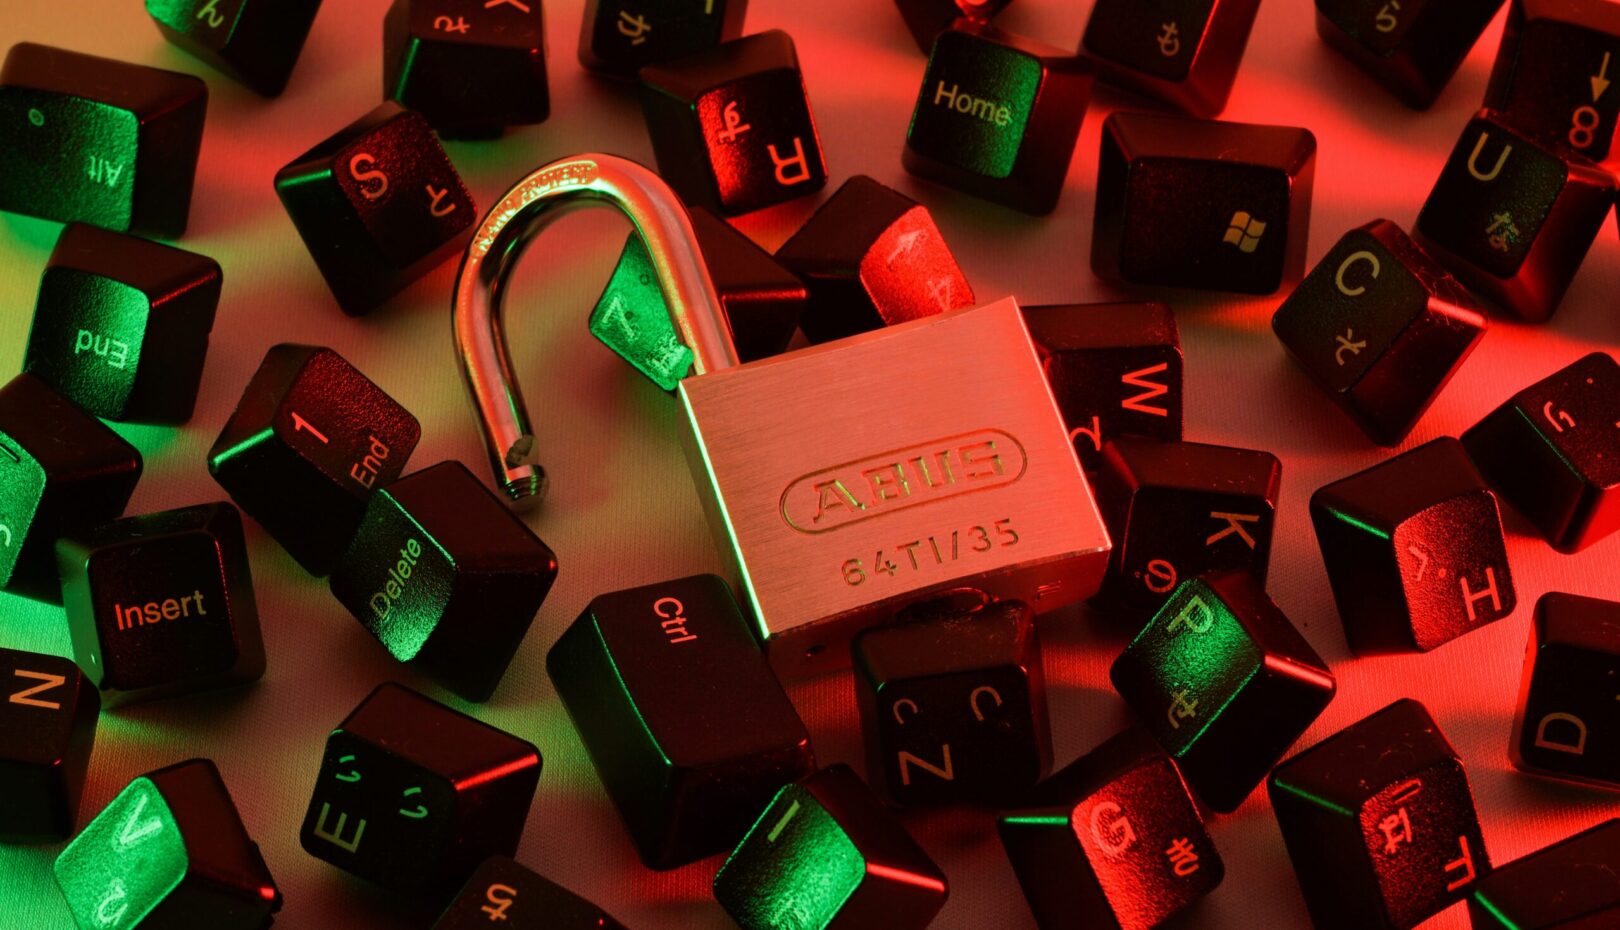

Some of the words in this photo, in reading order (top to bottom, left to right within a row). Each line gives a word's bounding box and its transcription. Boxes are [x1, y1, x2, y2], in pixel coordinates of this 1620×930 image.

[618, 10, 651, 46] か
[718, 100, 751, 142] す
[933, 79, 1013, 128] Home
[1568, 105, 1600, 149] 8
[87, 156, 124, 188] Alt
[350, 153, 388, 199] S
[766, 137, 811, 186] R
[1467, 131, 1513, 182] U
[425, 184, 457, 218] と
[1335, 250, 1381, 297] C
[74, 329, 129, 369] End
[1335, 328, 1367, 367] そ
[1121, 362, 1169, 418] W
[291, 411, 329, 445] 1
[350, 434, 390, 490] End
[812, 440, 1004, 524] ABUS
[1206, 510, 1261, 551] K
[369, 538, 422, 621] Delete
[1144, 559, 1177, 593] の
[1460, 567, 1502, 622] H
[114, 589, 207, 631] Insert
[653, 597, 698, 644] Ctrl
[1167, 595, 1214, 634] P
[1534, 711, 1588, 755] D
[119, 793, 163, 845] V
[313, 801, 367, 854] E
[1090, 801, 1137, 860] G
[1378, 807, 1413, 855] は
[1165, 837, 1200, 877] き
[1443, 834, 1477, 893] F
